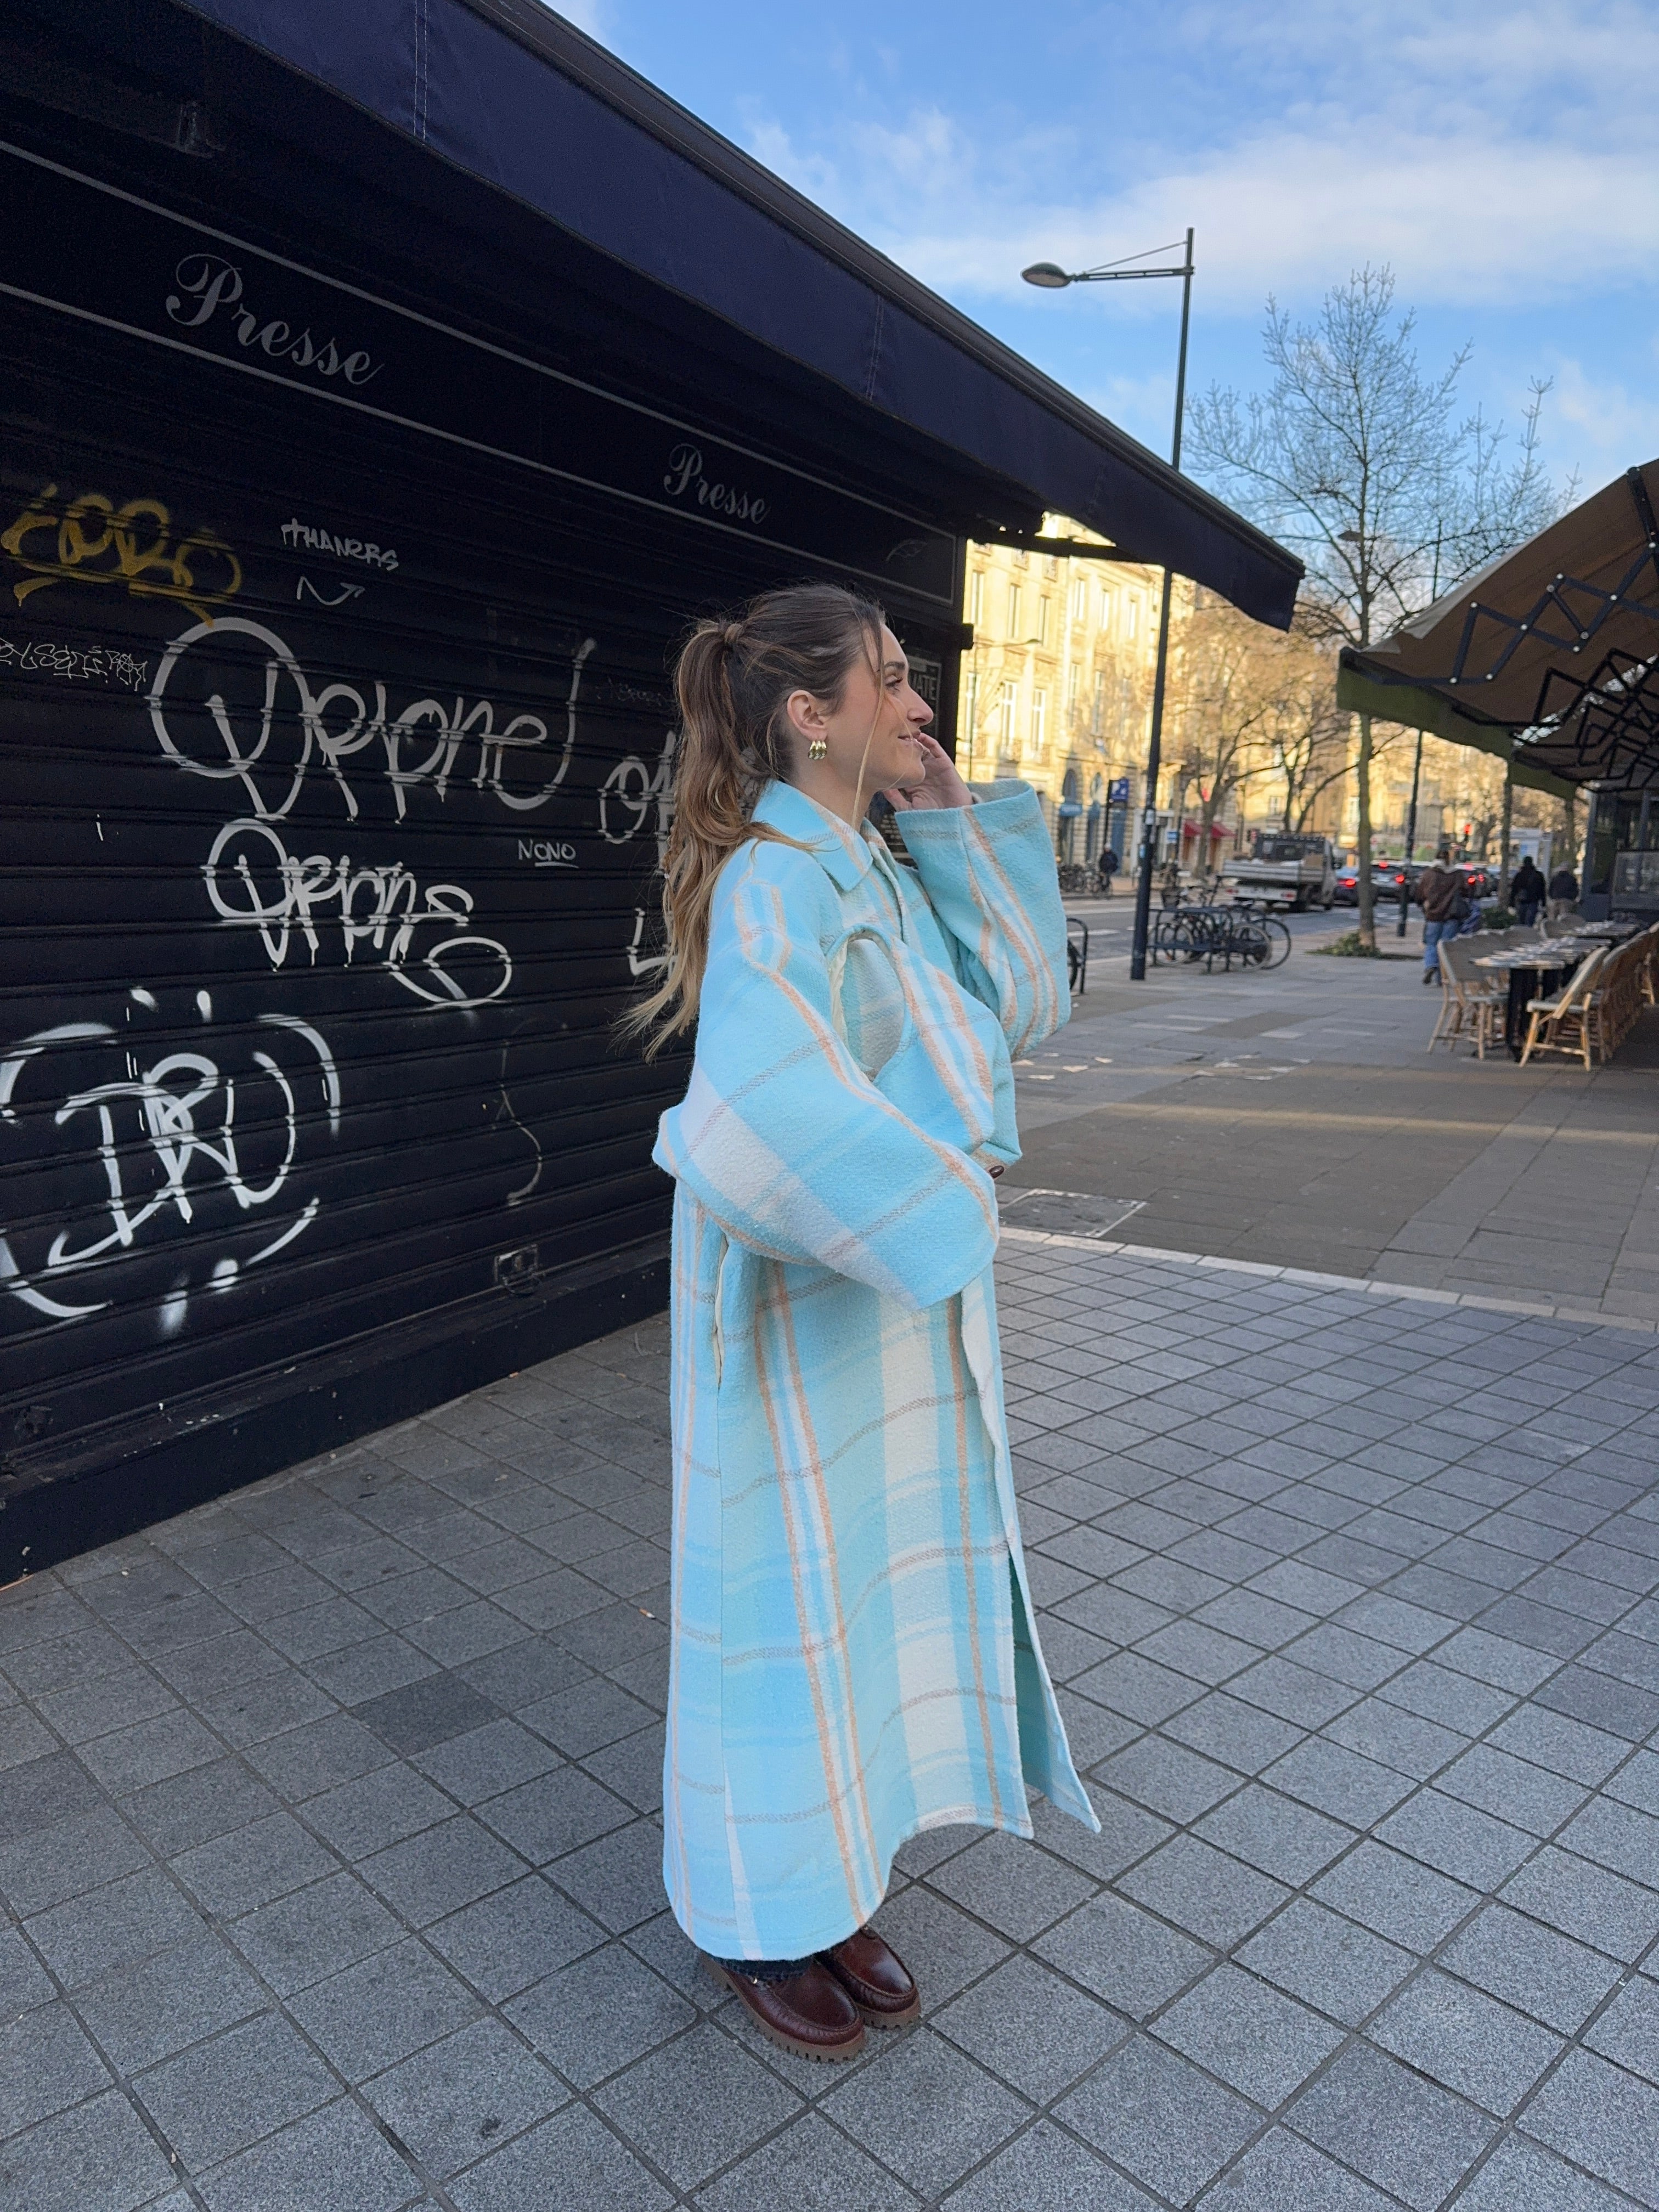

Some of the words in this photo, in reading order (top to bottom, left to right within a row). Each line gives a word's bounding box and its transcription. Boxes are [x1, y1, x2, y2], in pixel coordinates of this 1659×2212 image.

[166, 253, 385, 385] Presse
[663, 443, 769, 524] Presse
[518, 839, 577, 861] NONO
